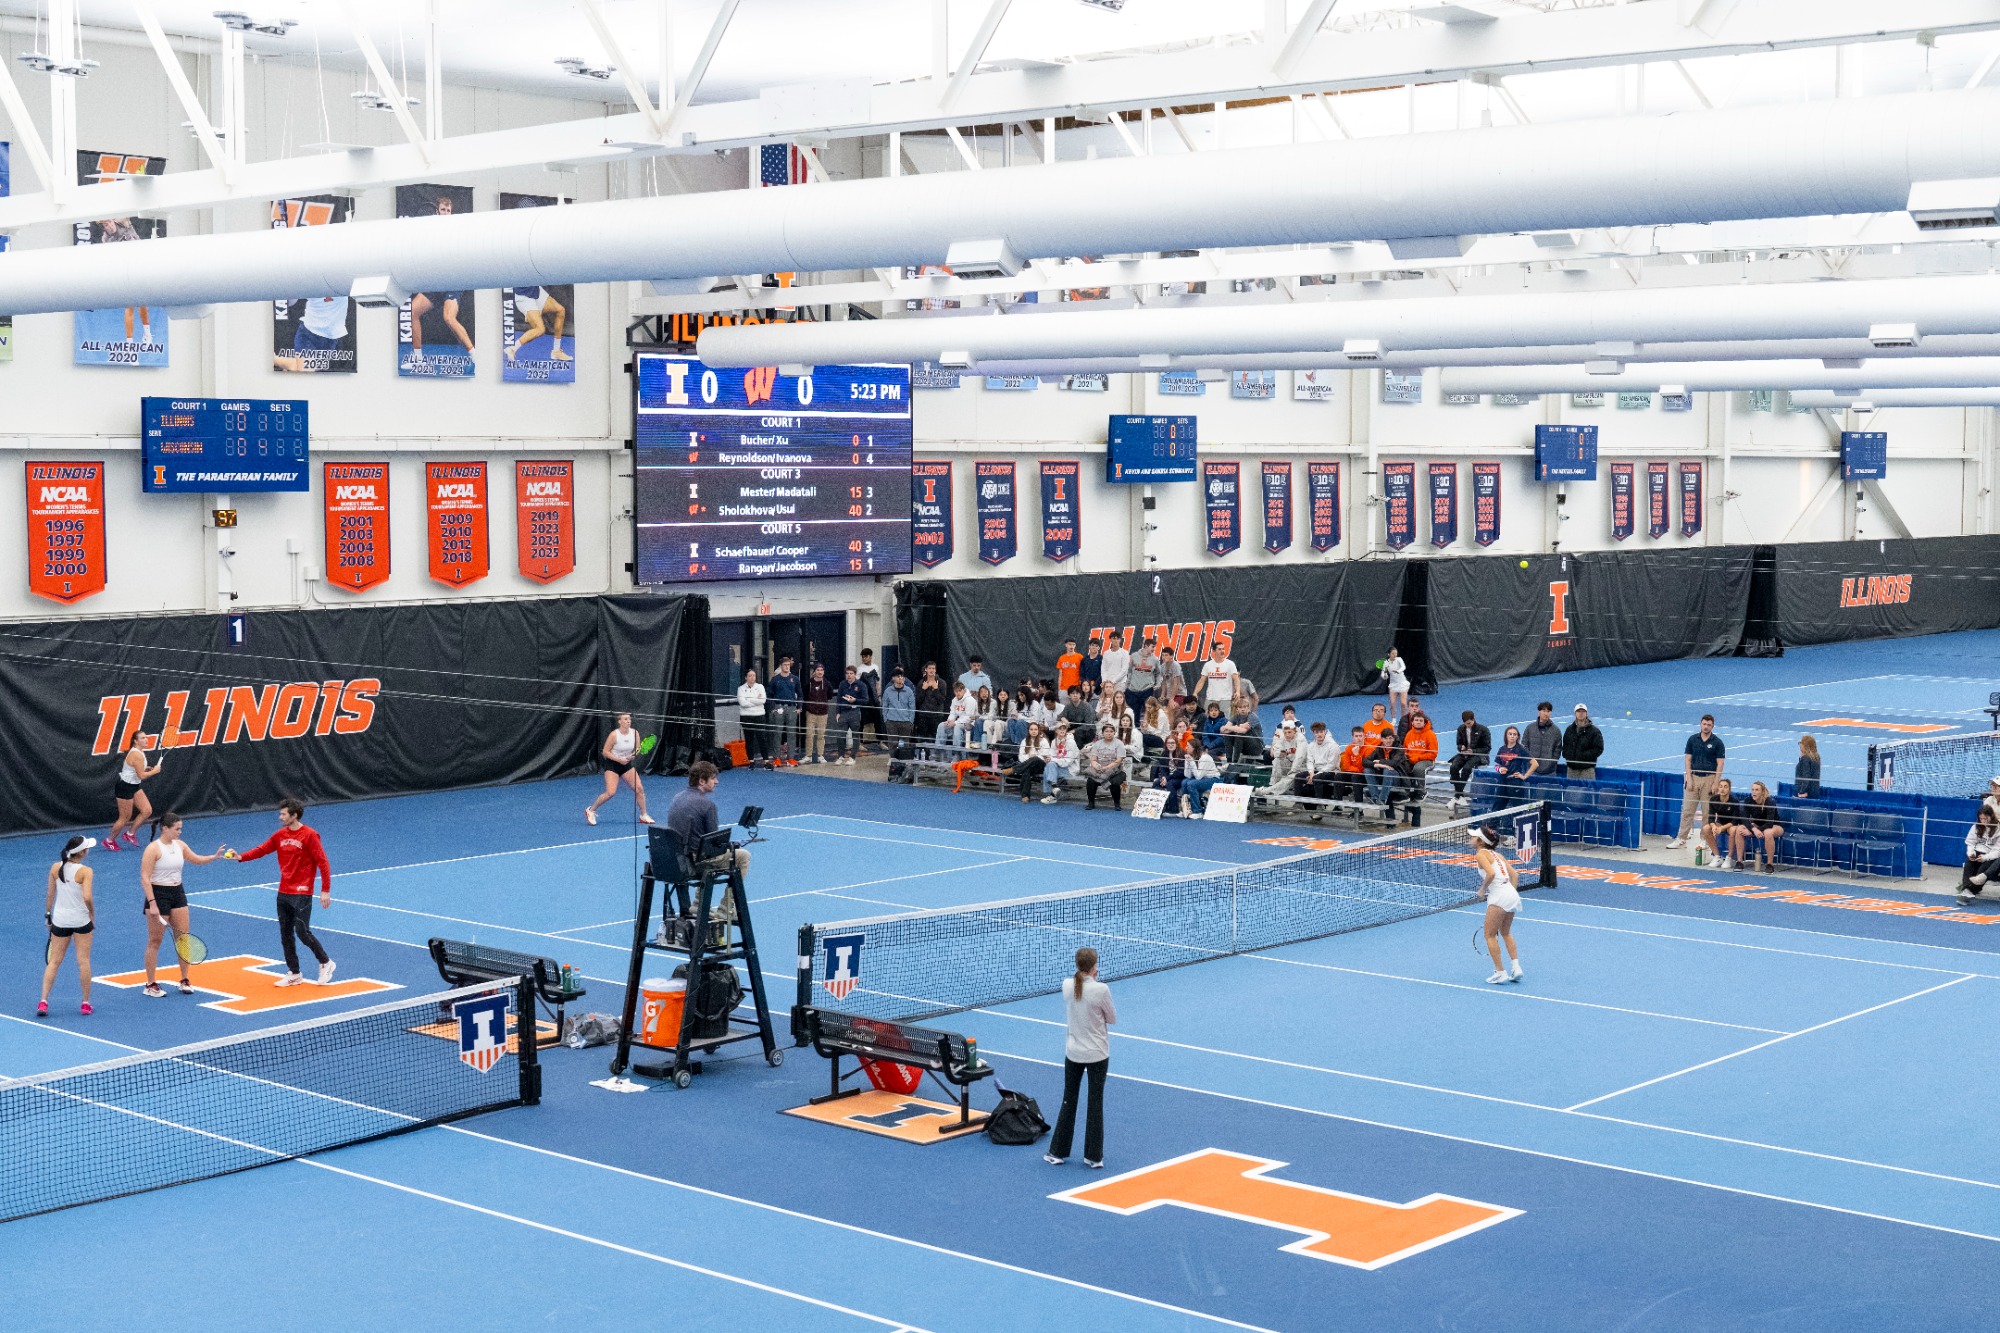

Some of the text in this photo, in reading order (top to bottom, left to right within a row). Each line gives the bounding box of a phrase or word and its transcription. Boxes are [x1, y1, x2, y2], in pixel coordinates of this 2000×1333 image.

[81, 341, 164, 353] ALL-AMERICAN
[109, 352, 138, 363] 2020
[278, 348, 354, 361] ALL-AMERICAN
[402, 354, 472, 366] ALL-AMERICAN
[303, 359, 329, 370] 2023
[441, 364, 464, 375] 2024
[507, 360, 571, 370] ALL-AMERICAN
[527, 370, 549, 379] 2025
[701, 370, 718, 404] 0
[797, 375, 813, 406] 0
[851, 383, 877, 400] 5:23
[880, 384, 901, 400] PM
[171, 402, 291, 412] COURT 1 GAMES SETS
[160, 414, 195, 427] ILLINOIS
[761, 417, 801, 428] COURT 1
[852, 435, 860, 446] 0
[867, 436, 873, 446] 1
[852, 454, 859, 464] 0
[866, 453, 873, 464] 4
[32, 467, 97, 480] ILLINOIS
[176, 472, 196, 481] THE
[197, 472, 261, 481] PARASTARAN
[262, 472, 299, 481] FAMILY
[329, 467, 383, 479] ILLINOIS
[431, 466, 482, 478] ILLINOIS
[520, 465, 568, 477] ILLINOIS
[761, 468, 801, 479] COURT 3
[40, 486, 88, 503] NCAA
[335, 485, 375, 500] NCAA
[437, 483, 474, 498] NCAA
[526, 481, 561, 496] NCAA
[850, 487, 862, 498] 15
[866, 487, 873, 498] 3
[530, 511, 560, 522] 2019
[849, 505, 862, 517] 40
[866, 504, 873, 516] 2
[918, 505, 940, 516] NCAA
[339, 515, 373, 527] 2001
[440, 513, 473, 525] 2009
[45, 519, 86, 532] 1996
[531, 523, 559, 534] 2023
[761, 523, 801, 535] COURT 5
[339, 529, 374, 541] 2003
[441, 526, 473, 538] 2010
[914, 531, 945, 545] 2003
[1045, 528, 1073, 541] 2007
[46, 534, 84, 547] 1997
[441, 539, 472, 551] 2012
[530, 535, 560, 547] 2024
[848, 541, 862, 552] 40
[865, 541, 872, 552] 3
[338, 542, 374, 553] 2004
[531, 547, 559, 559] 2025
[45, 548, 86, 561] 1999
[441, 551, 473, 564] 2018
[339, 555, 375, 567] 2008
[849, 559, 862, 570] 15
[867, 559, 873, 570] 1
[44, 563, 88, 576] 2000
[1153, 575, 1161, 593] 2
[1840, 574, 1912, 607] ILLINOIS
[232, 618, 242, 643] 1
[91, 678, 381, 756] ILLINOIS
[645, 1001, 657, 1017] G
